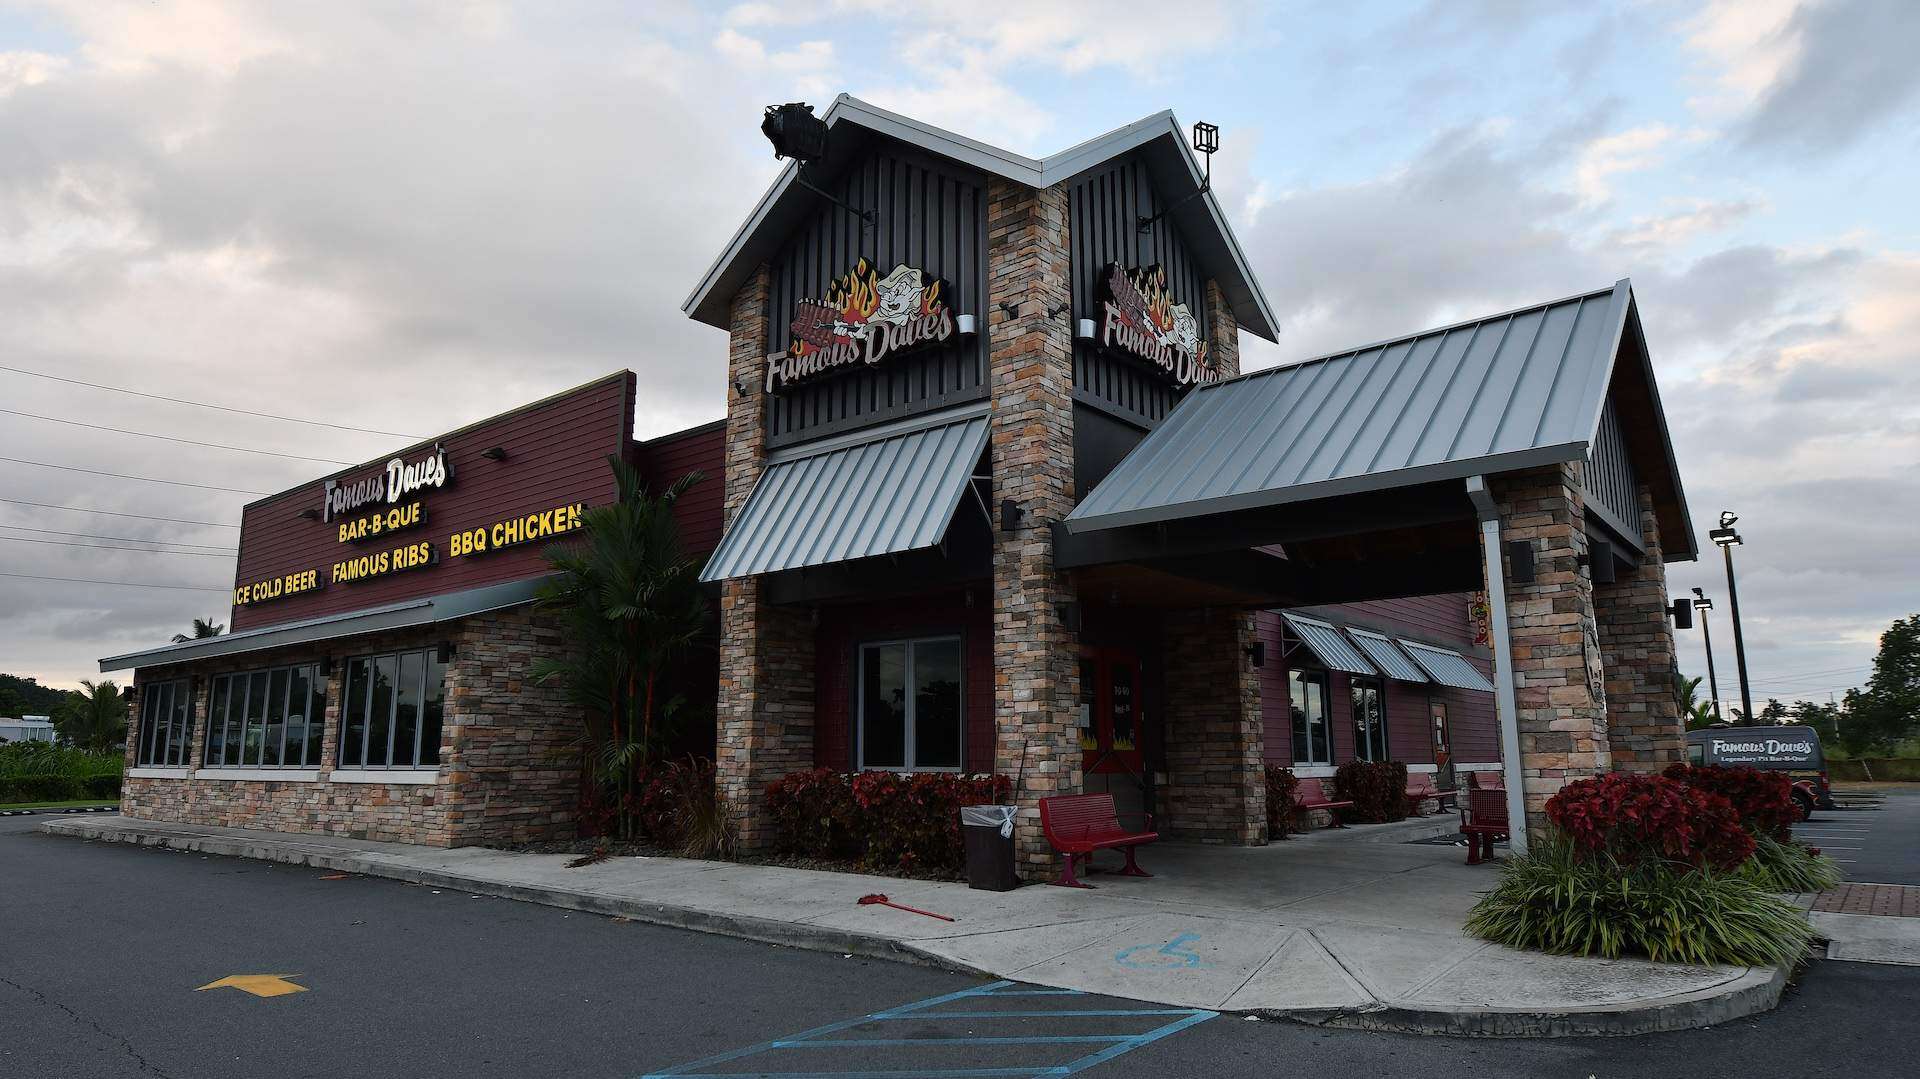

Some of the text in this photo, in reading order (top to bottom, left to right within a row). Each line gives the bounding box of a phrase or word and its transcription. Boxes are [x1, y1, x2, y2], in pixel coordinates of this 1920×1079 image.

[1104, 301, 1174, 371] Famous
[766, 336, 860, 394] Famous
[323, 442, 446, 523] Famous Dave's
[338, 502, 420, 543] BAR-B-QUE
[450, 503, 582, 557] BBQ CHICKEN
[332, 542, 430, 583] FAMOUS RIBS
[233, 569, 317, 605] ICE COLD BEER
[1712, 739, 1812, 755] Famous Dave's
